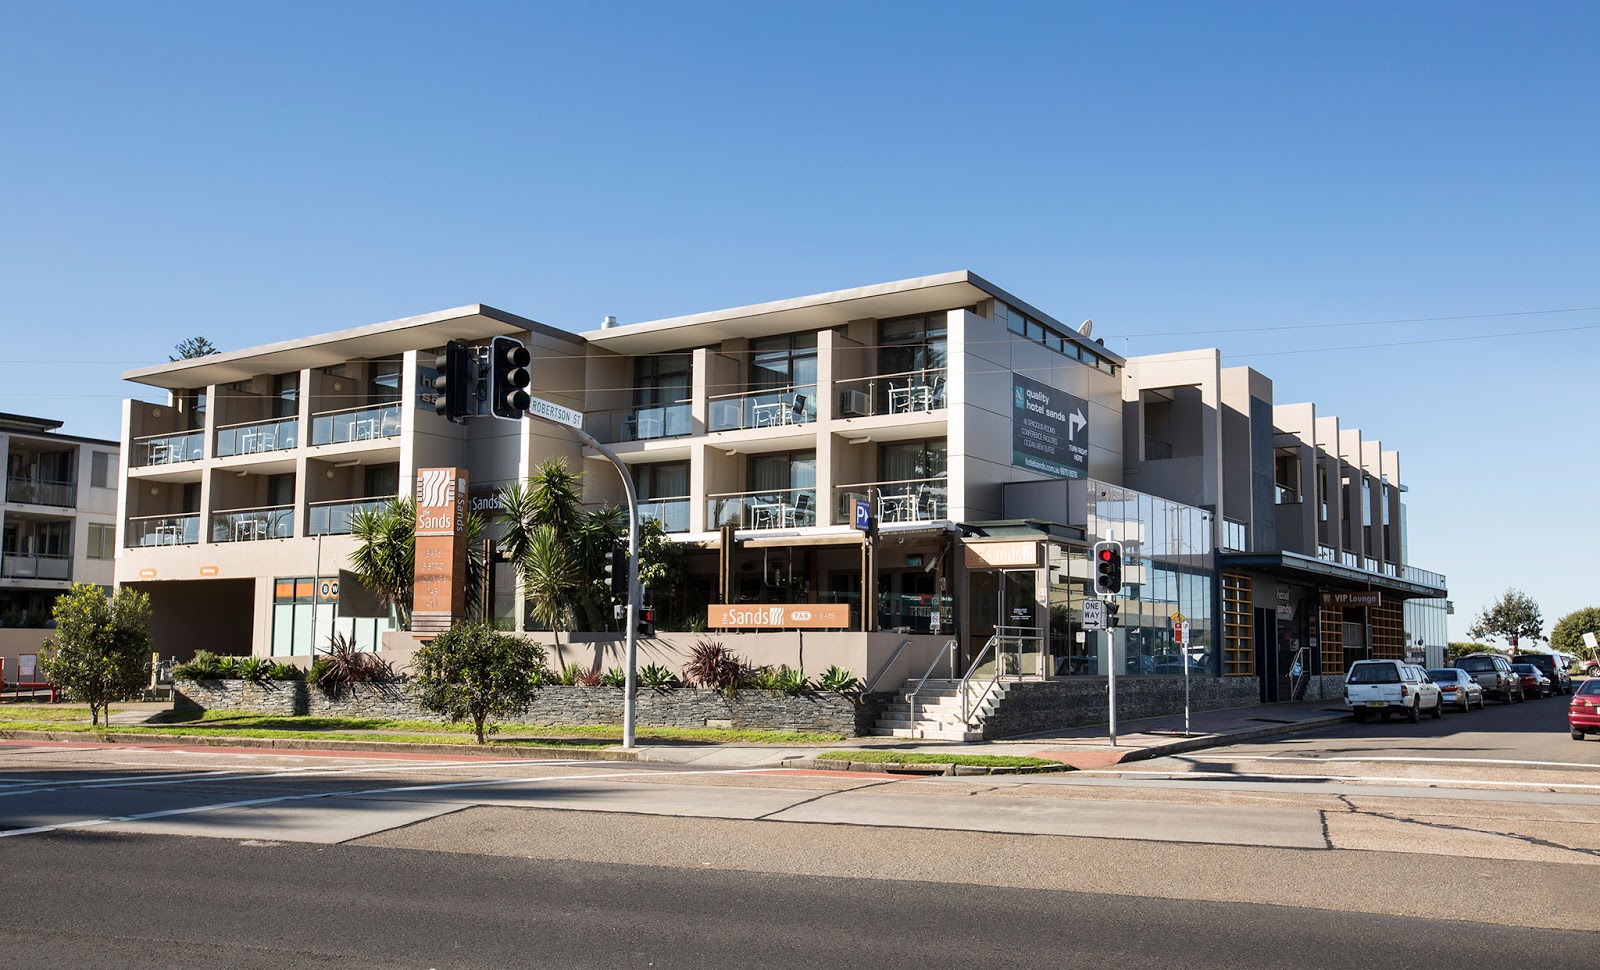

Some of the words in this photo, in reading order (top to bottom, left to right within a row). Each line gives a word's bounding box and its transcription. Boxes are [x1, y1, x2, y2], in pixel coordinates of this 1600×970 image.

[1026, 389, 1049, 405] quality
[532, 400, 571, 422] ROBERTSON
[573, 414, 581, 425] ST
[1026, 400, 1044, 415] hotel
[1045, 408, 1066, 422] sands
[1069, 444, 1077, 453] TURN
[1077, 447, 1088, 456] RIGHT
[1073, 453, 1083, 463] HERE
[472, 493, 498, 511] Sands
[419, 512, 451, 529] Sands
[456, 499, 465, 532] Sands
[856, 505, 865, 524] P
[985, 544, 1021, 562] Sands
[1085, 602, 1099, 610] ONE
[1334, 594, 1348, 603] VIP
[1349, 594, 1377, 604] Lounge
[729, 606, 769, 625] Sands
[1084, 611, 1100, 619] WAY
